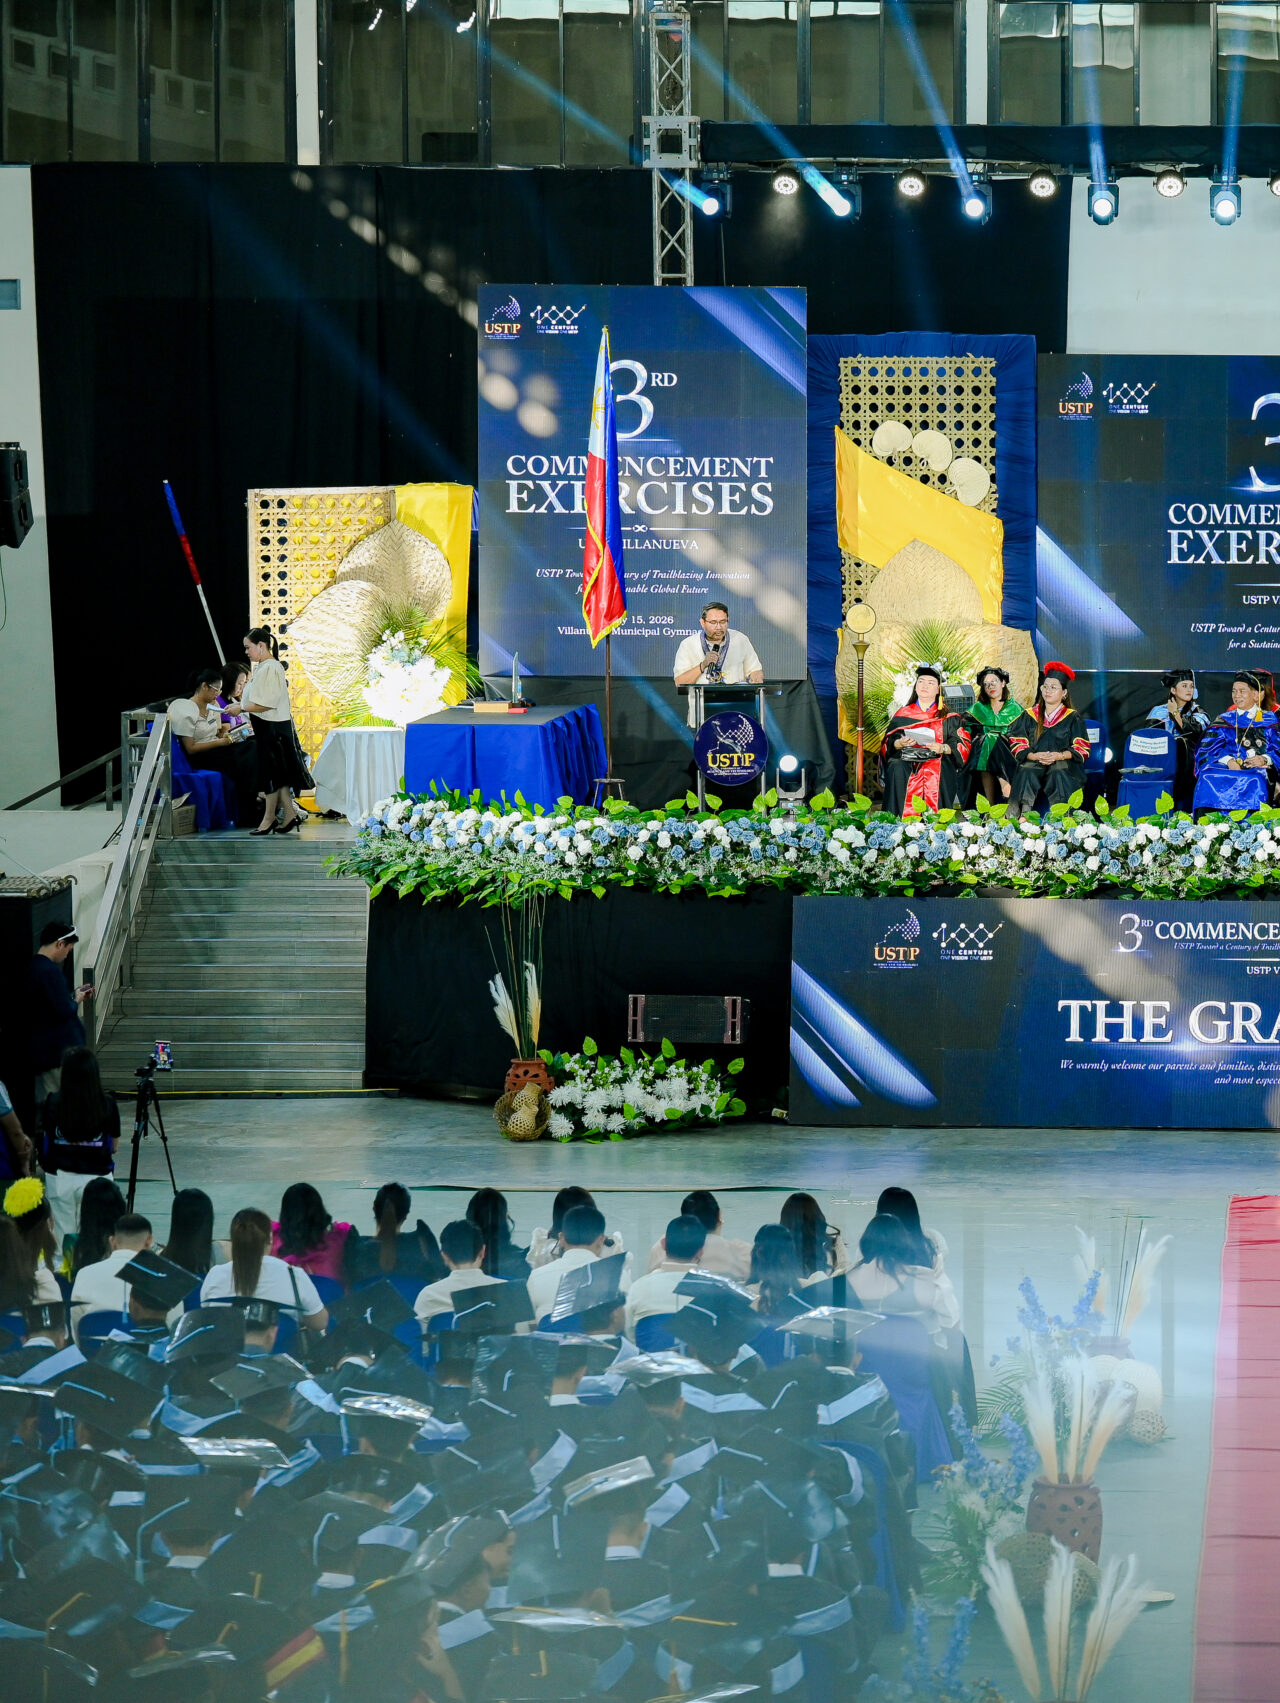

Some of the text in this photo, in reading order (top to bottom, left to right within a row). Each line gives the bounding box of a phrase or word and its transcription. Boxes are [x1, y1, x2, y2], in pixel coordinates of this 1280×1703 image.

[485, 323, 521, 334] USTP
[1059, 402, 1093, 414] USTP
[506, 455, 774, 478] COMNCEMENT
[622, 538, 699, 550] ILLANUEVA
[536, 568, 564, 578] USTP
[641, 570, 650, 581] of
[652, 570, 704, 581] Trailblazing
[705, 570, 750, 580] Innovation
[650, 584, 679, 594] Global
[681, 585, 709, 595] Future
[1242, 595, 1270, 605] USTP
[649, 616, 674, 625] 2026
[611, 627, 660, 638] Municipal
[663, 627, 703, 638] Gymnas
[1190, 623, 1216, 633] USTP
[1218, 623, 1245, 633] Toward
[1227, 639, 1240, 651] for
[707, 753, 755, 767] USTP
[1225, 942, 1251, 951] Century
[874, 946, 921, 961] USTP
[1246, 966, 1271, 974] USTP
[1057, 1000, 1174, 1043] THE
[1060, 1060, 1073, 1070] We
[1076, 1060, 1108, 1072] warmly
[1110, 1060, 1146, 1070] welcome
[1164, 1062, 1197, 1072] parents
[1199, 1061, 1216, 1070] and
[1217, 1060, 1255, 1072] families,
[1214, 1075, 1231, 1085] and
[1232, 1075, 1254, 1085] most
